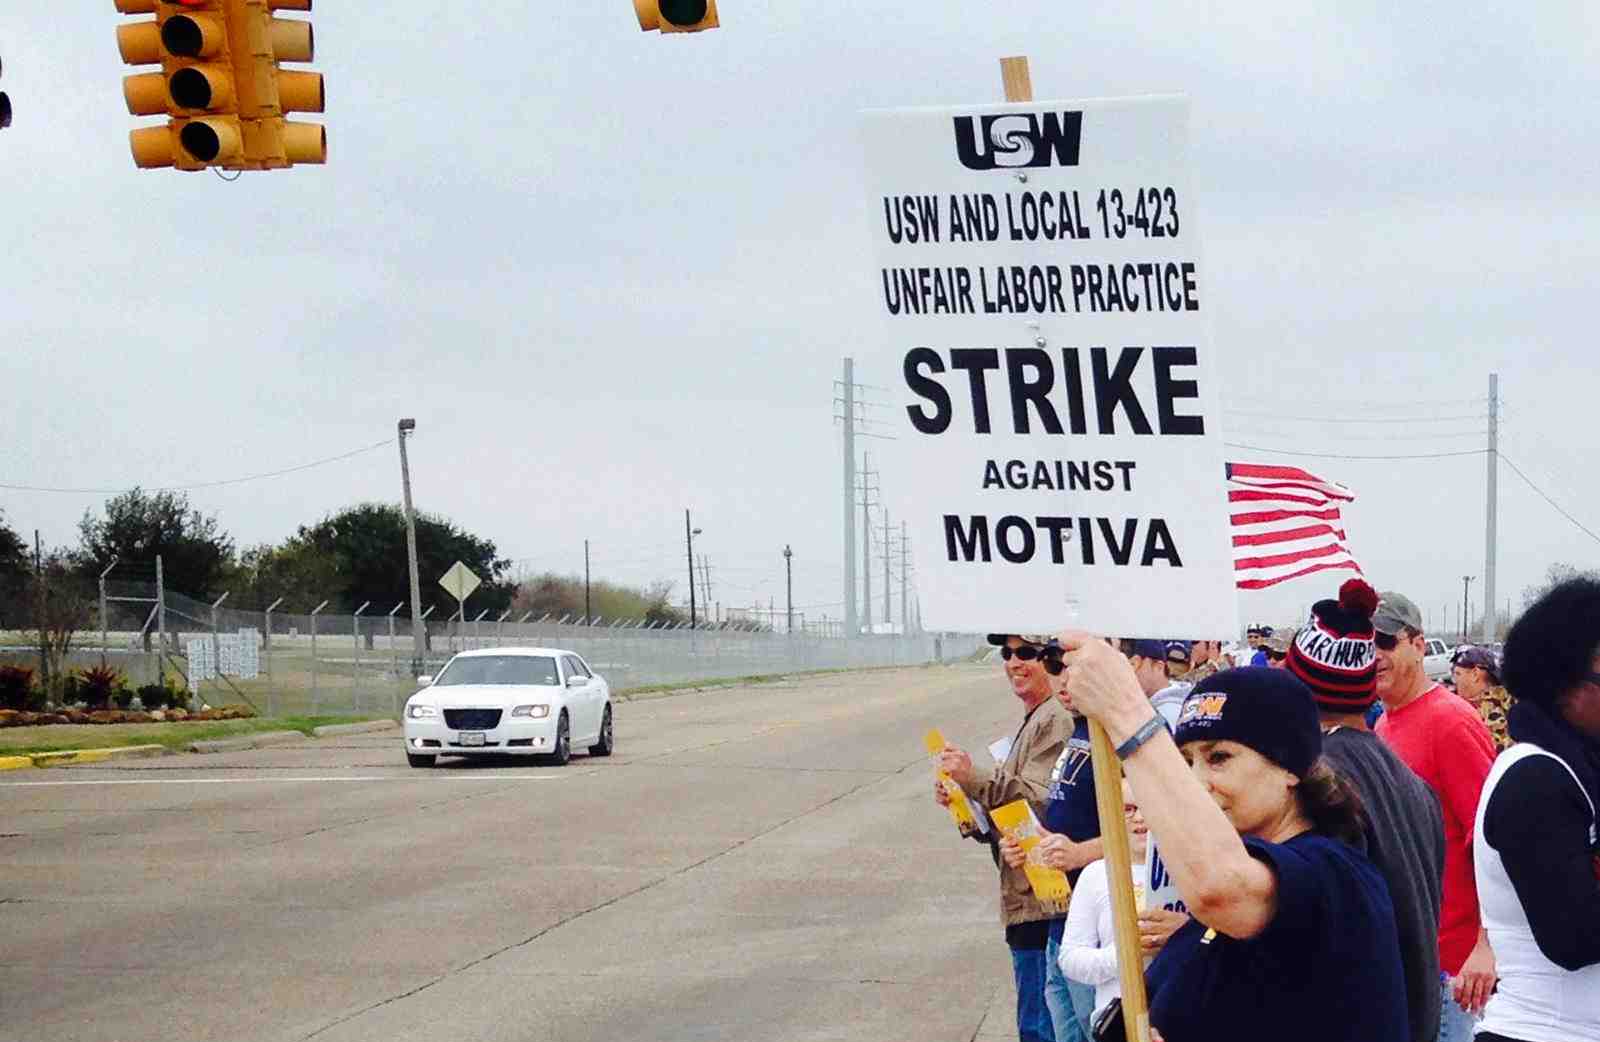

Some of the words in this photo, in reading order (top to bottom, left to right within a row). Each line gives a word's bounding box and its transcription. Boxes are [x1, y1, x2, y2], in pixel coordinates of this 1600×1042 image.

[953, 111, 1083, 170] USW
[884, 195, 940, 243] USW
[950, 193, 1000, 242] AND
[1007, 190, 1090, 241] LOCAL
[1097, 187, 1179, 239] 13-423
[882, 267, 976, 315] UNFAIR
[981, 265, 1065, 314] LABOR
[1072, 262, 1199, 313] PRACTICE
[903, 346, 1205, 436] STRIKE
[982, 460, 1136, 492] AGAINST
[943, 514, 1183, 568] MOTIVA
[1304, 634, 1367, 668] ARTHUR
